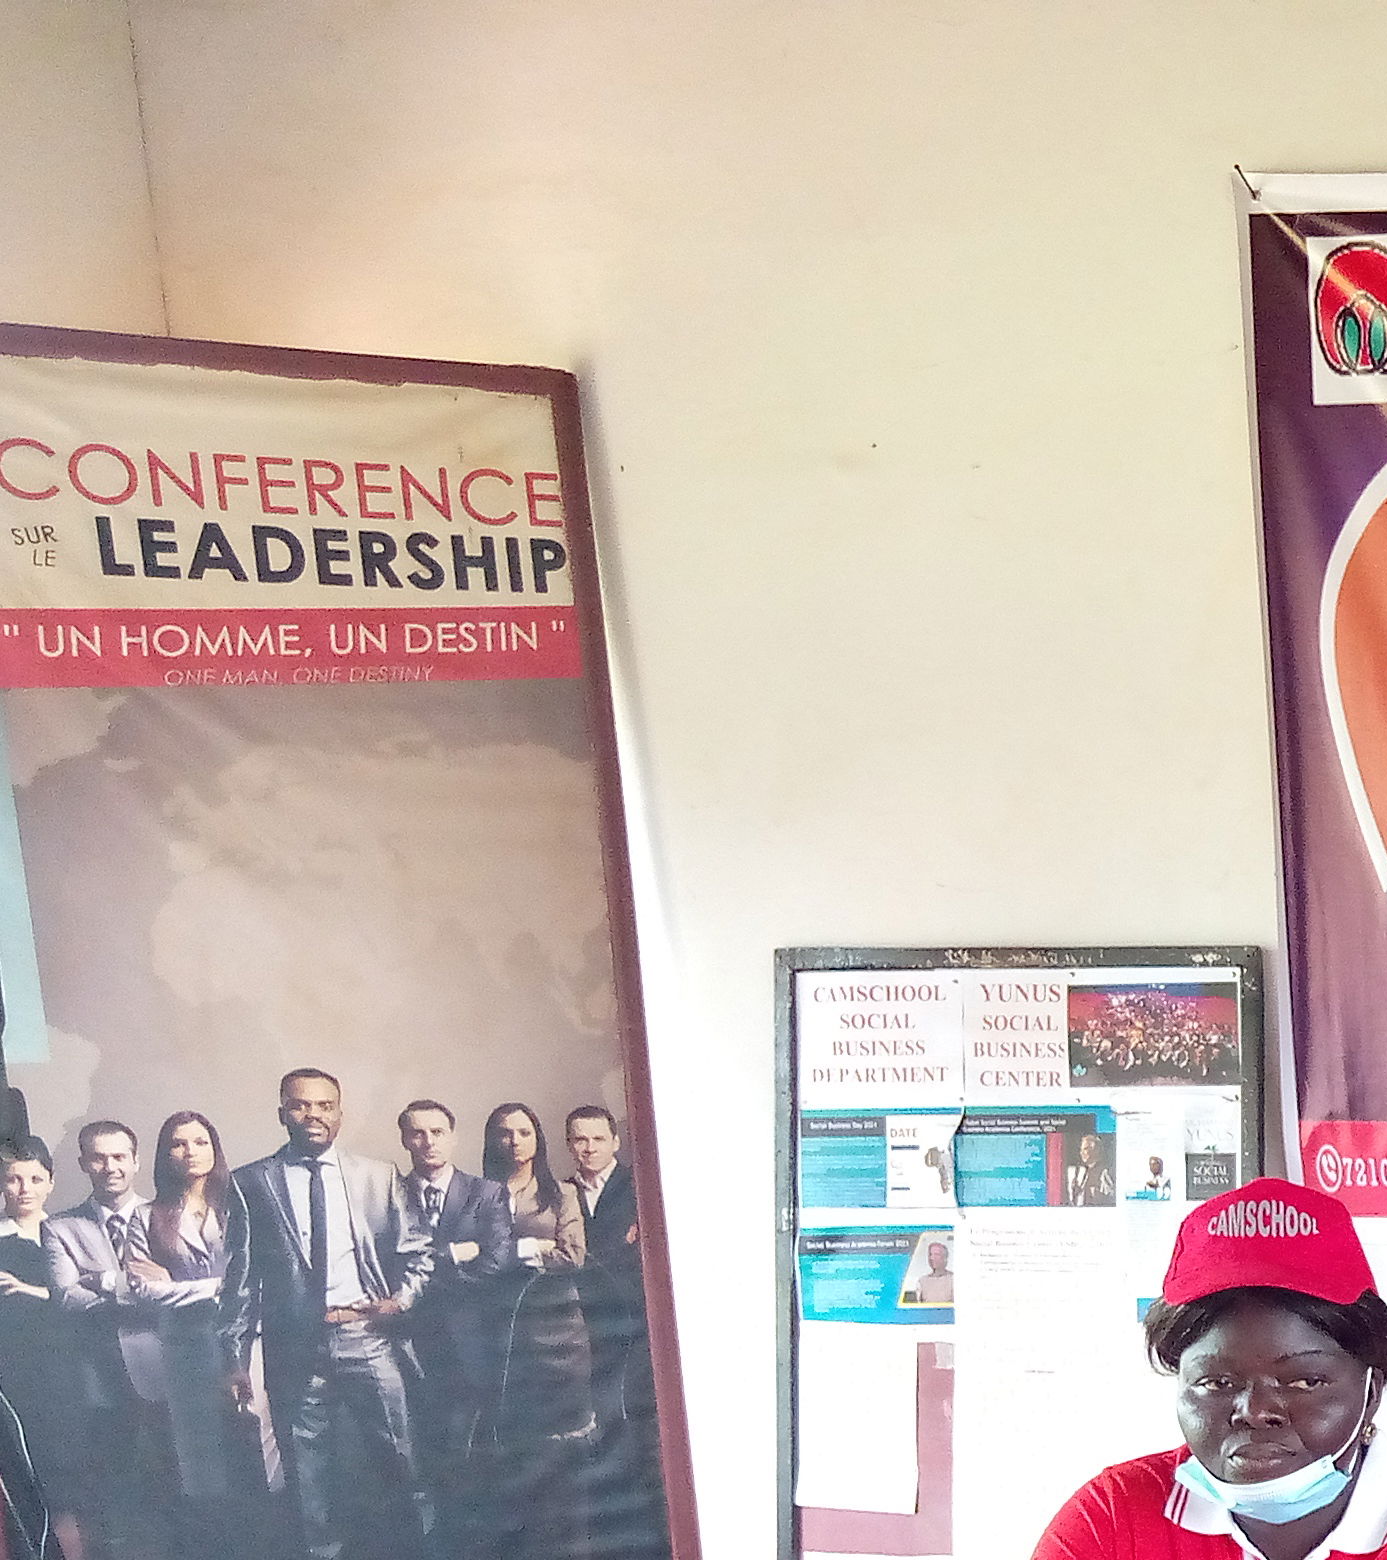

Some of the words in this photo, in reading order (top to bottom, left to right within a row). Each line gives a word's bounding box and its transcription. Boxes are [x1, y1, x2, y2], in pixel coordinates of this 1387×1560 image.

[0, 436, 564, 528] CONFERENCE
[11, 524, 57, 546] SUR
[33, 548, 57, 568] LE
[95, 515, 567, 594] LEADERSHIP
[119, 622, 313, 660] HOMME,
[329, 622, 388, 654] UN
[163, 669, 217, 687] ONE
[292, 666, 340, 684] ONE
[350, 665, 434, 684] DESTINY
[812, 984, 948, 1004] CAMSCHOOL
[979, 983, 1063, 1004] YUNUS
[839, 1013, 917, 1032] SOCIAL
[981, 1014, 1060, 1033] SOCIAL
[831, 1040, 927, 1058] BUSINESS
[973, 1040, 1066, 1060] BUSINESS
[812, 1066, 950, 1085] DEPARTMENT
[979, 1070, 1063, 1089] CENTER
[889, 1127, 918, 1139] DATE
[1207, 1199, 1320, 1239] CAMSCHOOL
